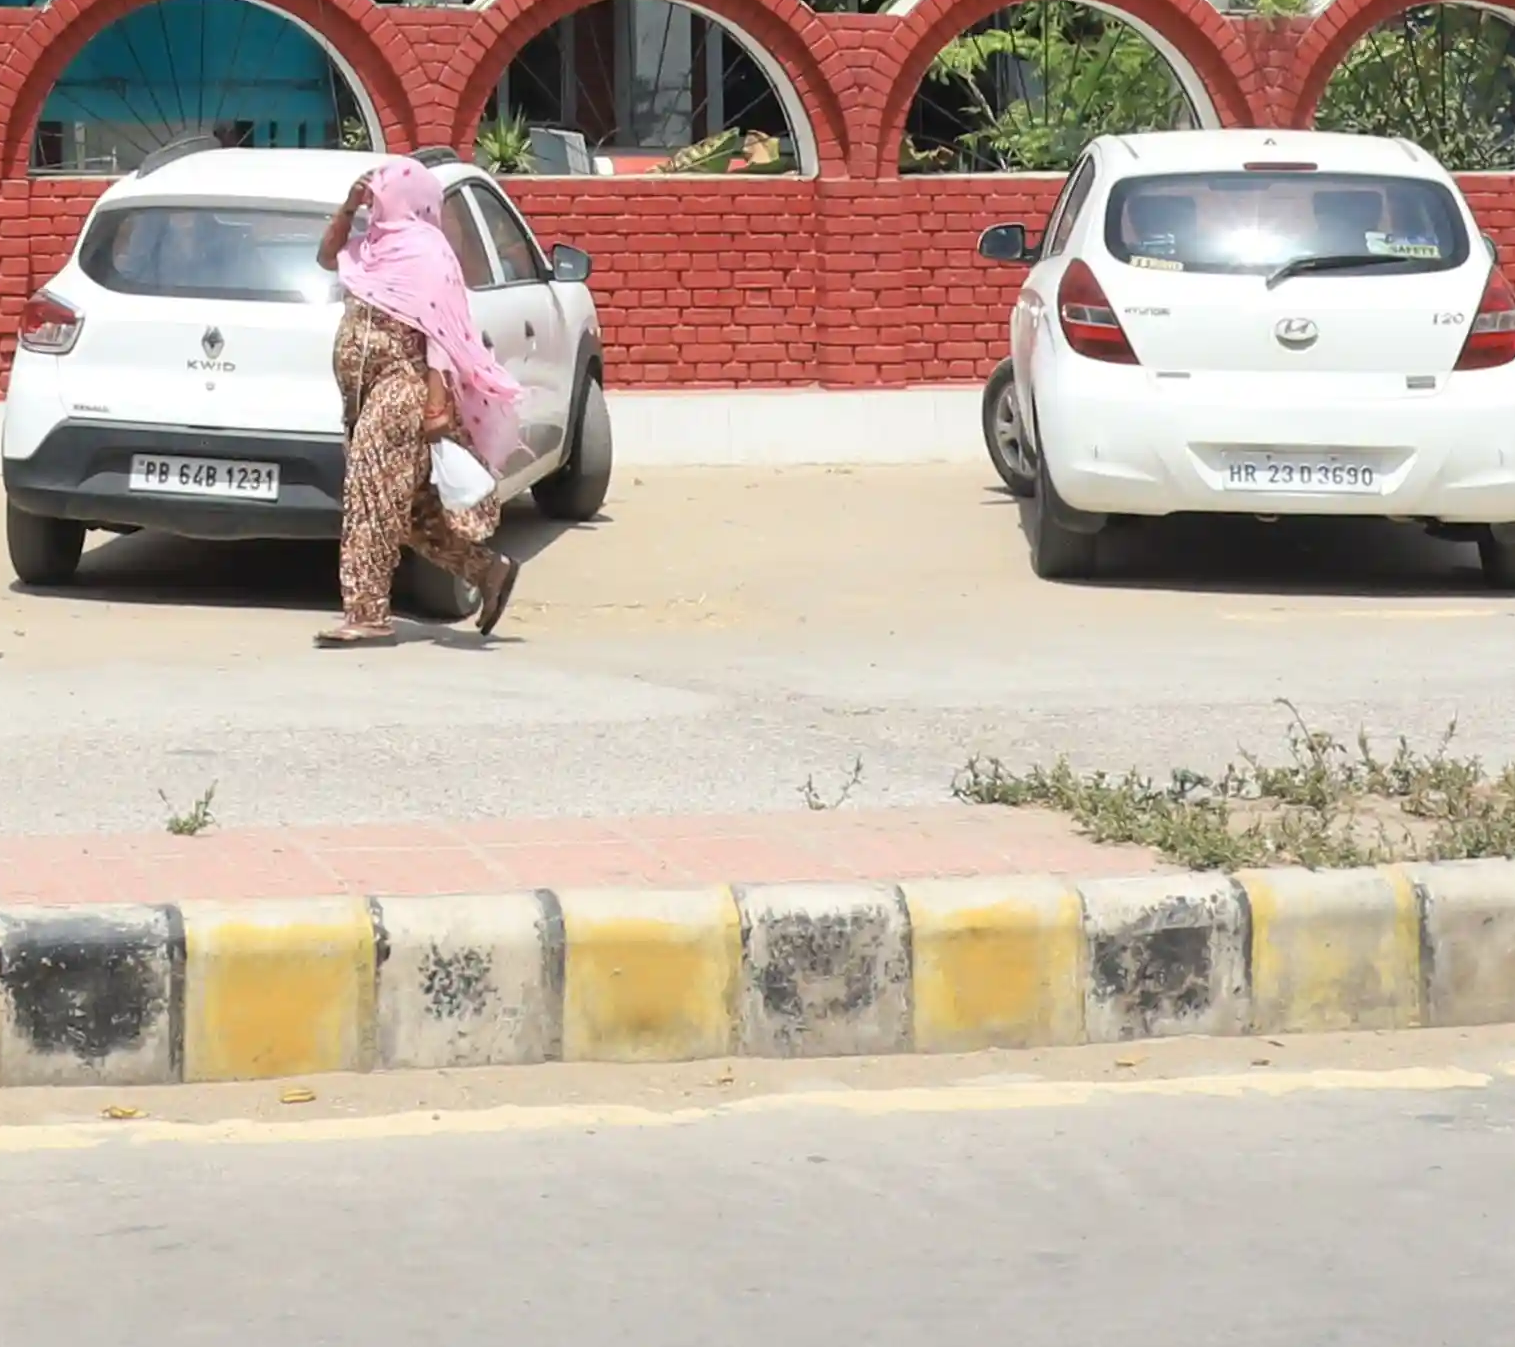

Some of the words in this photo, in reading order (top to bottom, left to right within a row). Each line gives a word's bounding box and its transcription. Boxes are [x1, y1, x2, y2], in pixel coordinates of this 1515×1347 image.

[187, 360, 235, 372] KWID
[145, 461, 169, 483] PB
[180, 464, 217, 487] 64B
[227, 468, 273, 491] 1231
[1230, 464, 1256, 484] HR
[1268, 464, 1294, 483] 23
[1318, 466, 1373, 486] 3690
